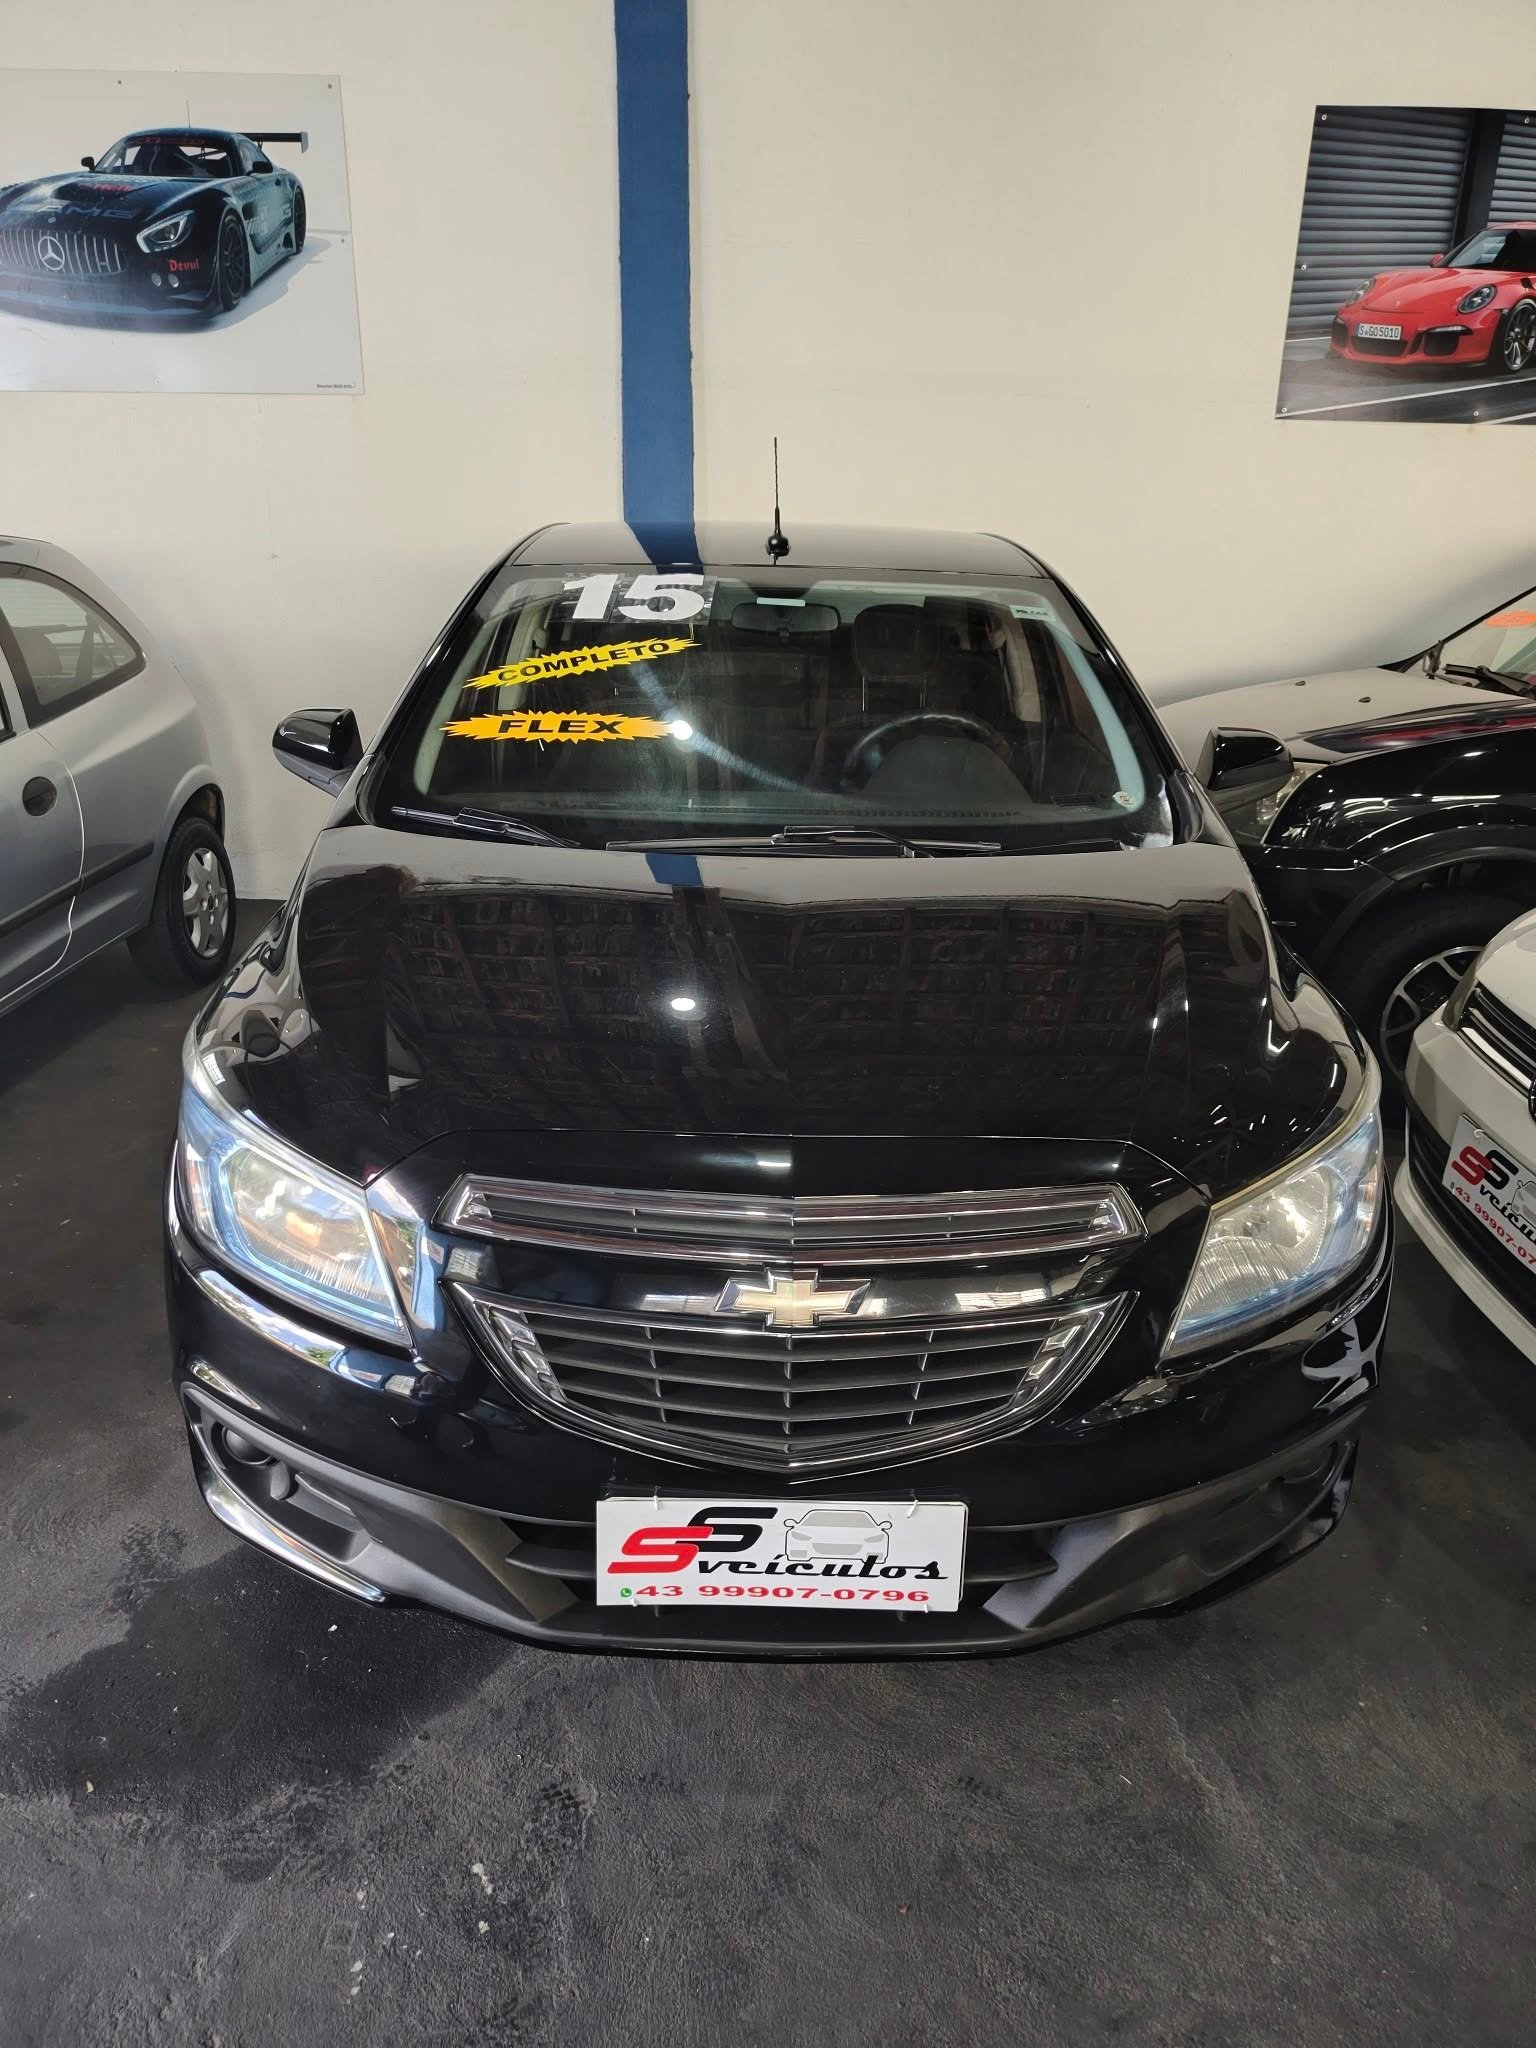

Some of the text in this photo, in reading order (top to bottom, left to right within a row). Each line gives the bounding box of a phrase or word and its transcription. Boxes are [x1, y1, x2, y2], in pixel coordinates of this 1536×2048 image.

[563, 573, 705, 621] 15
[498, 642, 670, 682] COMPLETO
[498, 719, 624, 734] FLEX
[1455, 1187, 1471, 1203] 43
[698, 1554, 949, 1580] veículos
[636, 1585, 930, 1603] 43 99907-0796
